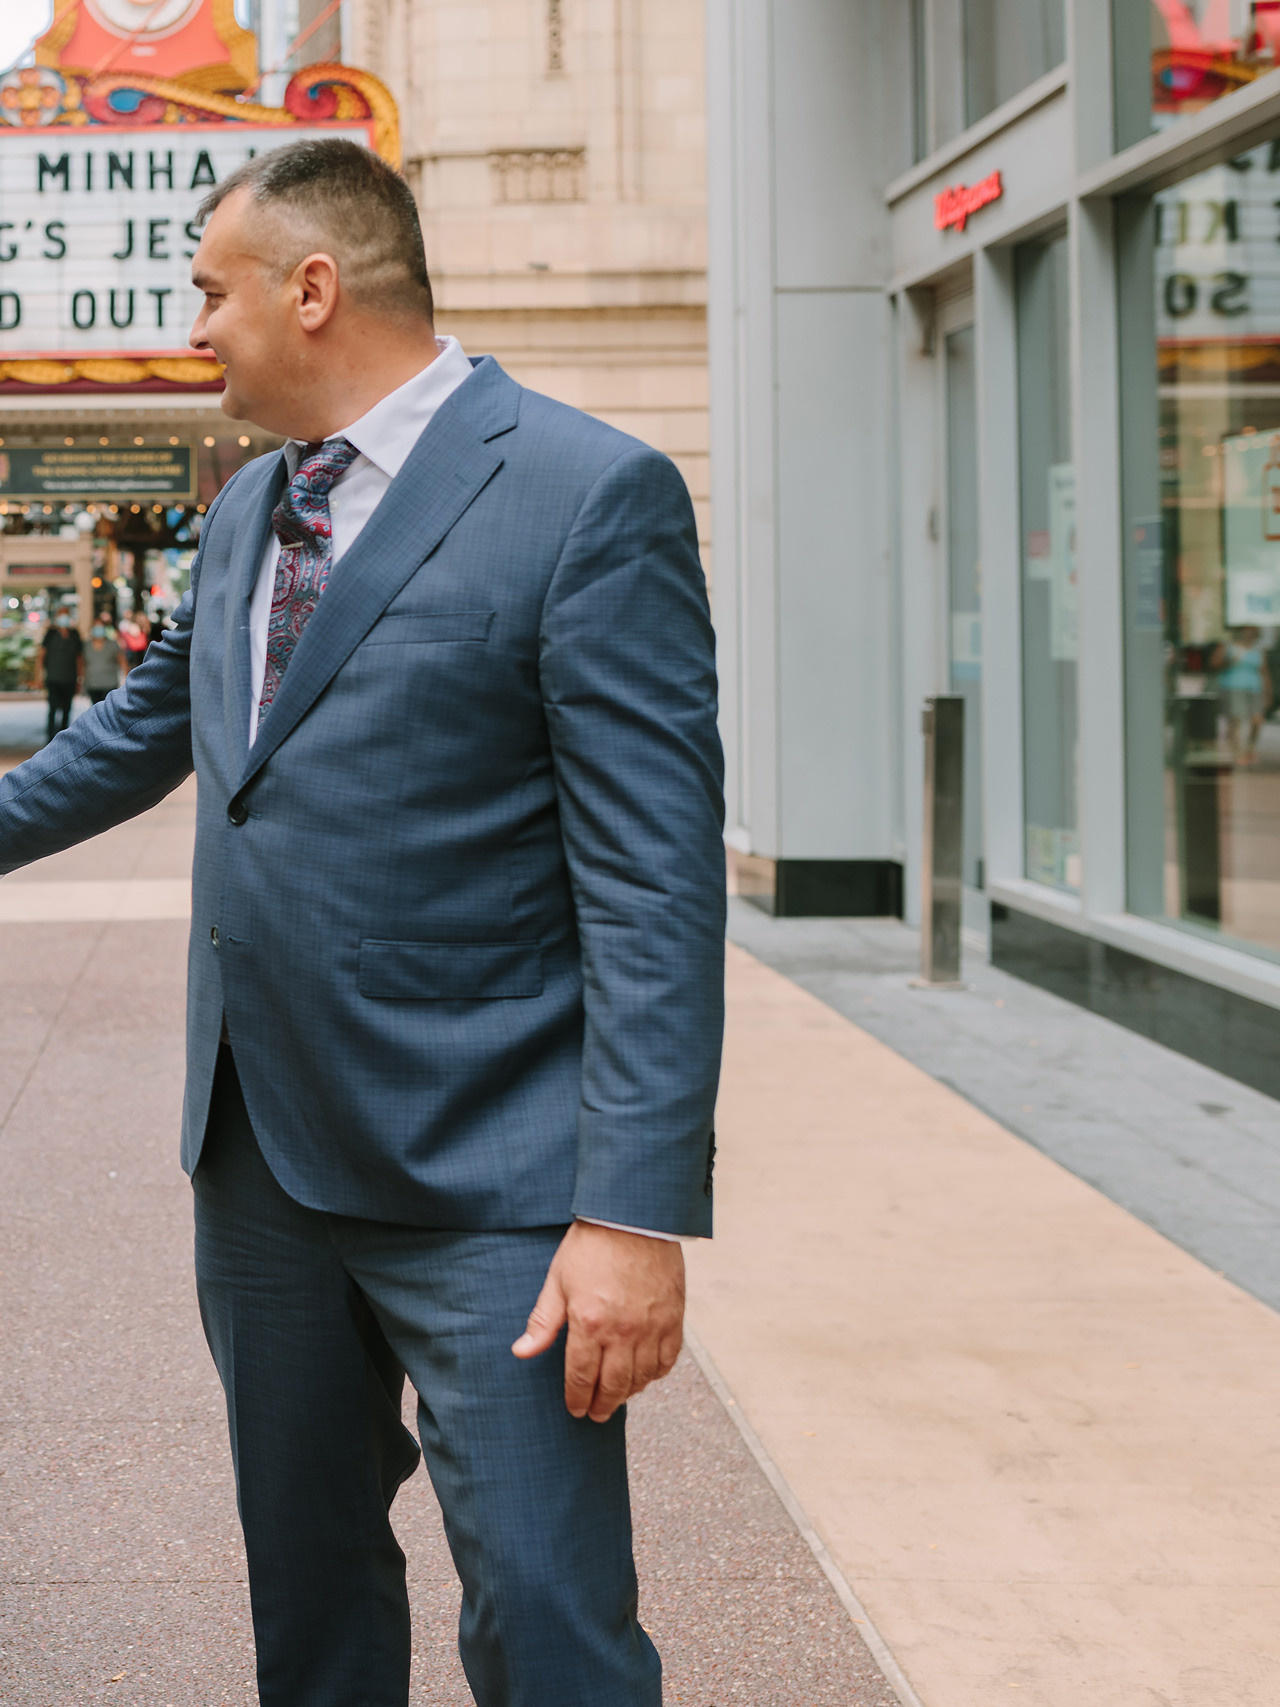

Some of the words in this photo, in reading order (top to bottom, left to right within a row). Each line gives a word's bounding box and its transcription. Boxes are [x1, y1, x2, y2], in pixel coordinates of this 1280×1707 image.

[37, 148, 256, 192] MINHA
[113, 218, 203, 260] JES
[71, 287, 173, 330] OUT
